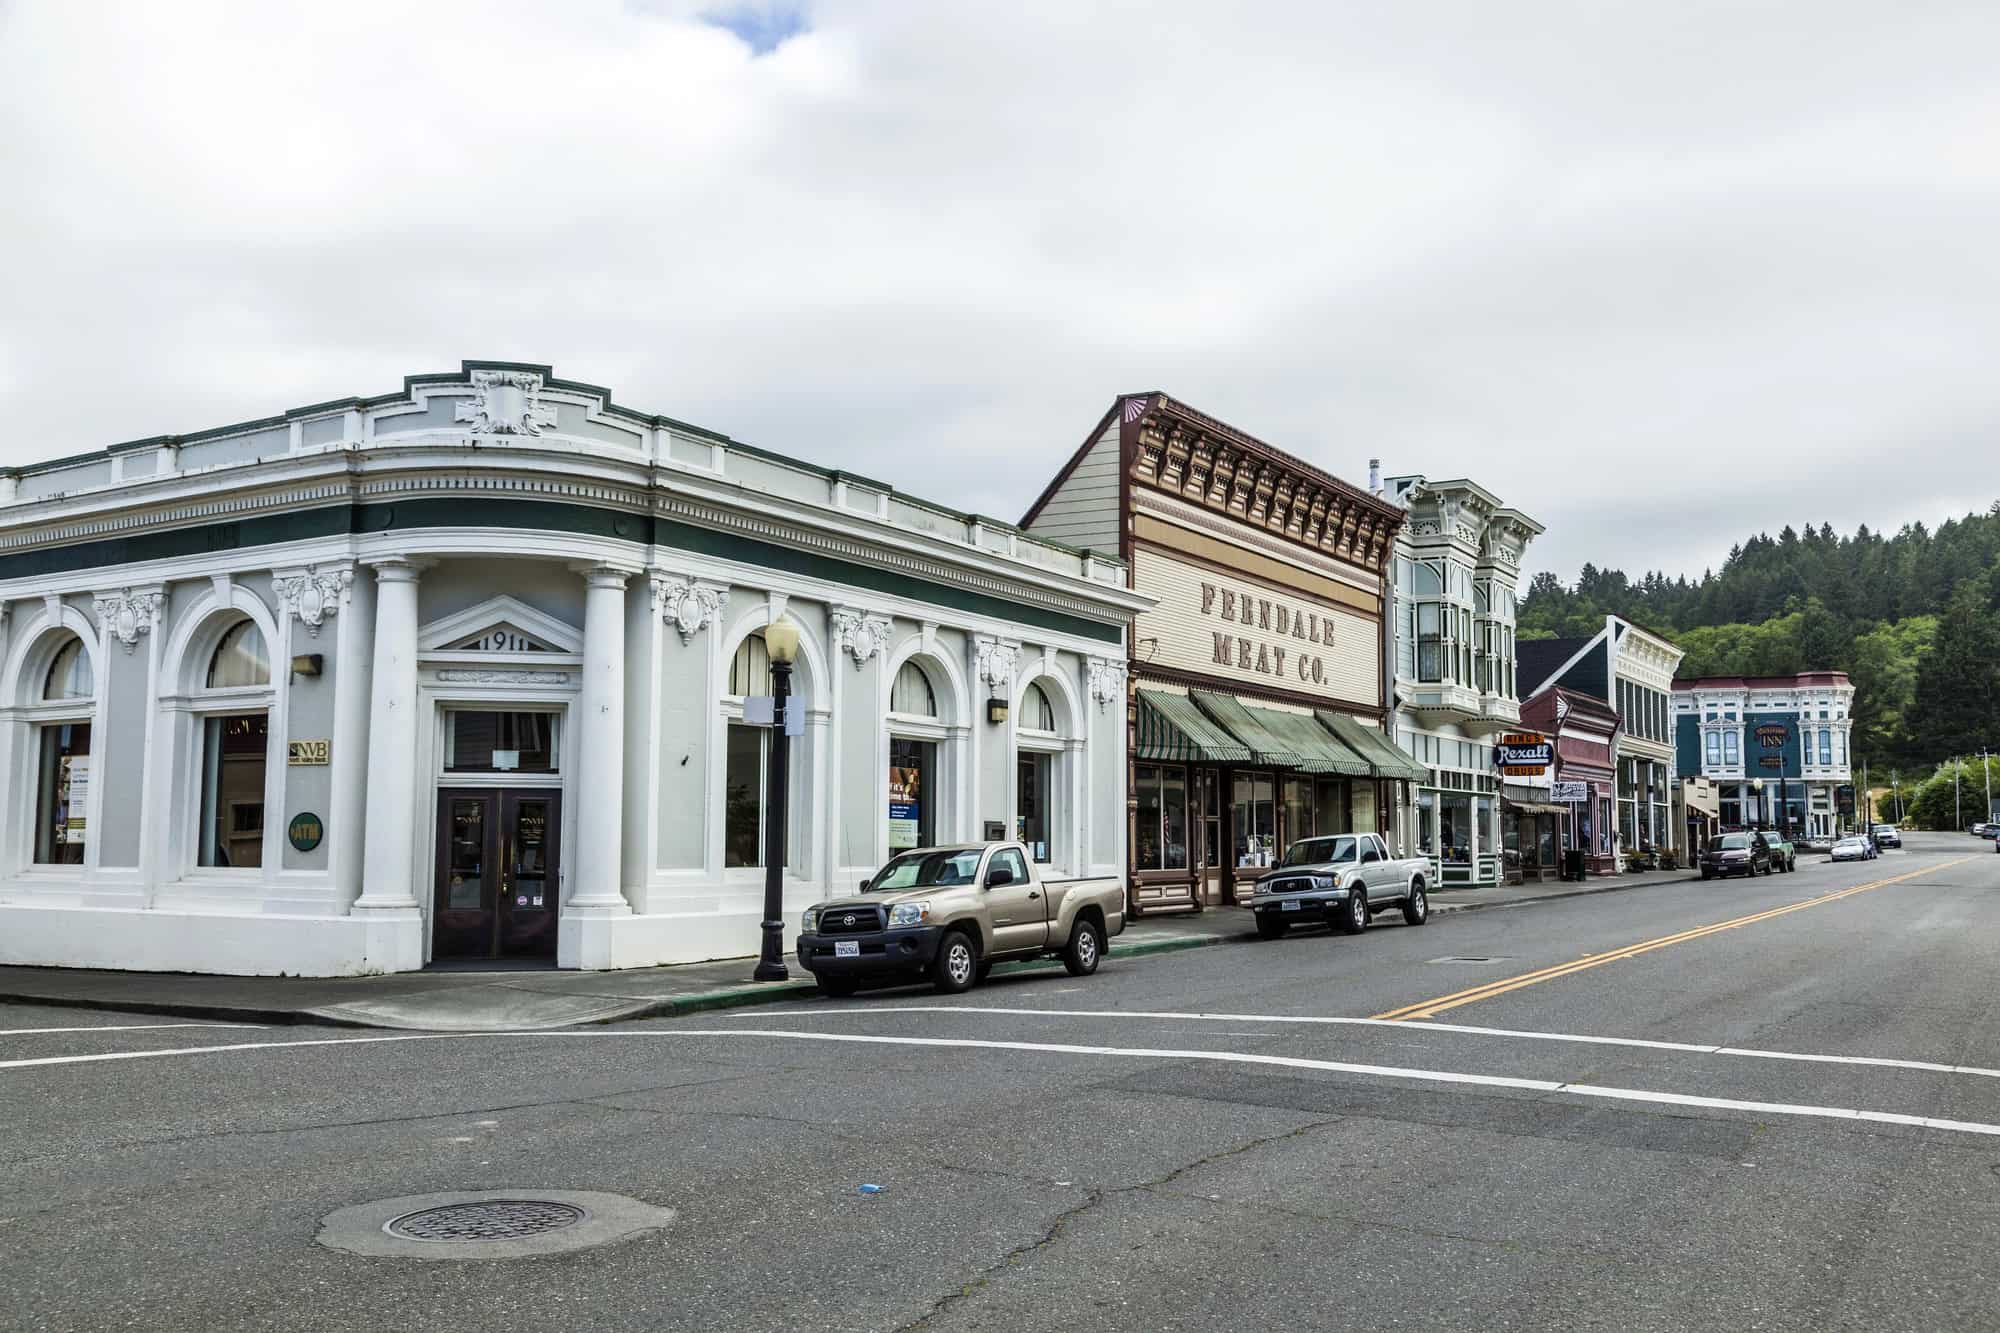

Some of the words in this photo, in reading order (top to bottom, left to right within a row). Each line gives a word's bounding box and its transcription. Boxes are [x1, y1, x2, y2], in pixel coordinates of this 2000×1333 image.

[1201, 582, 1335, 647] FERNDALE
[484, 631, 523, 650] 1911
[1212, 631, 1286, 677] MEAT
[1298, 653, 1329, 686] CO.
[298, 742, 327, 757] NVB
[1762, 735, 1782, 746] INN
[1498, 745, 1549, 764] Rexall
